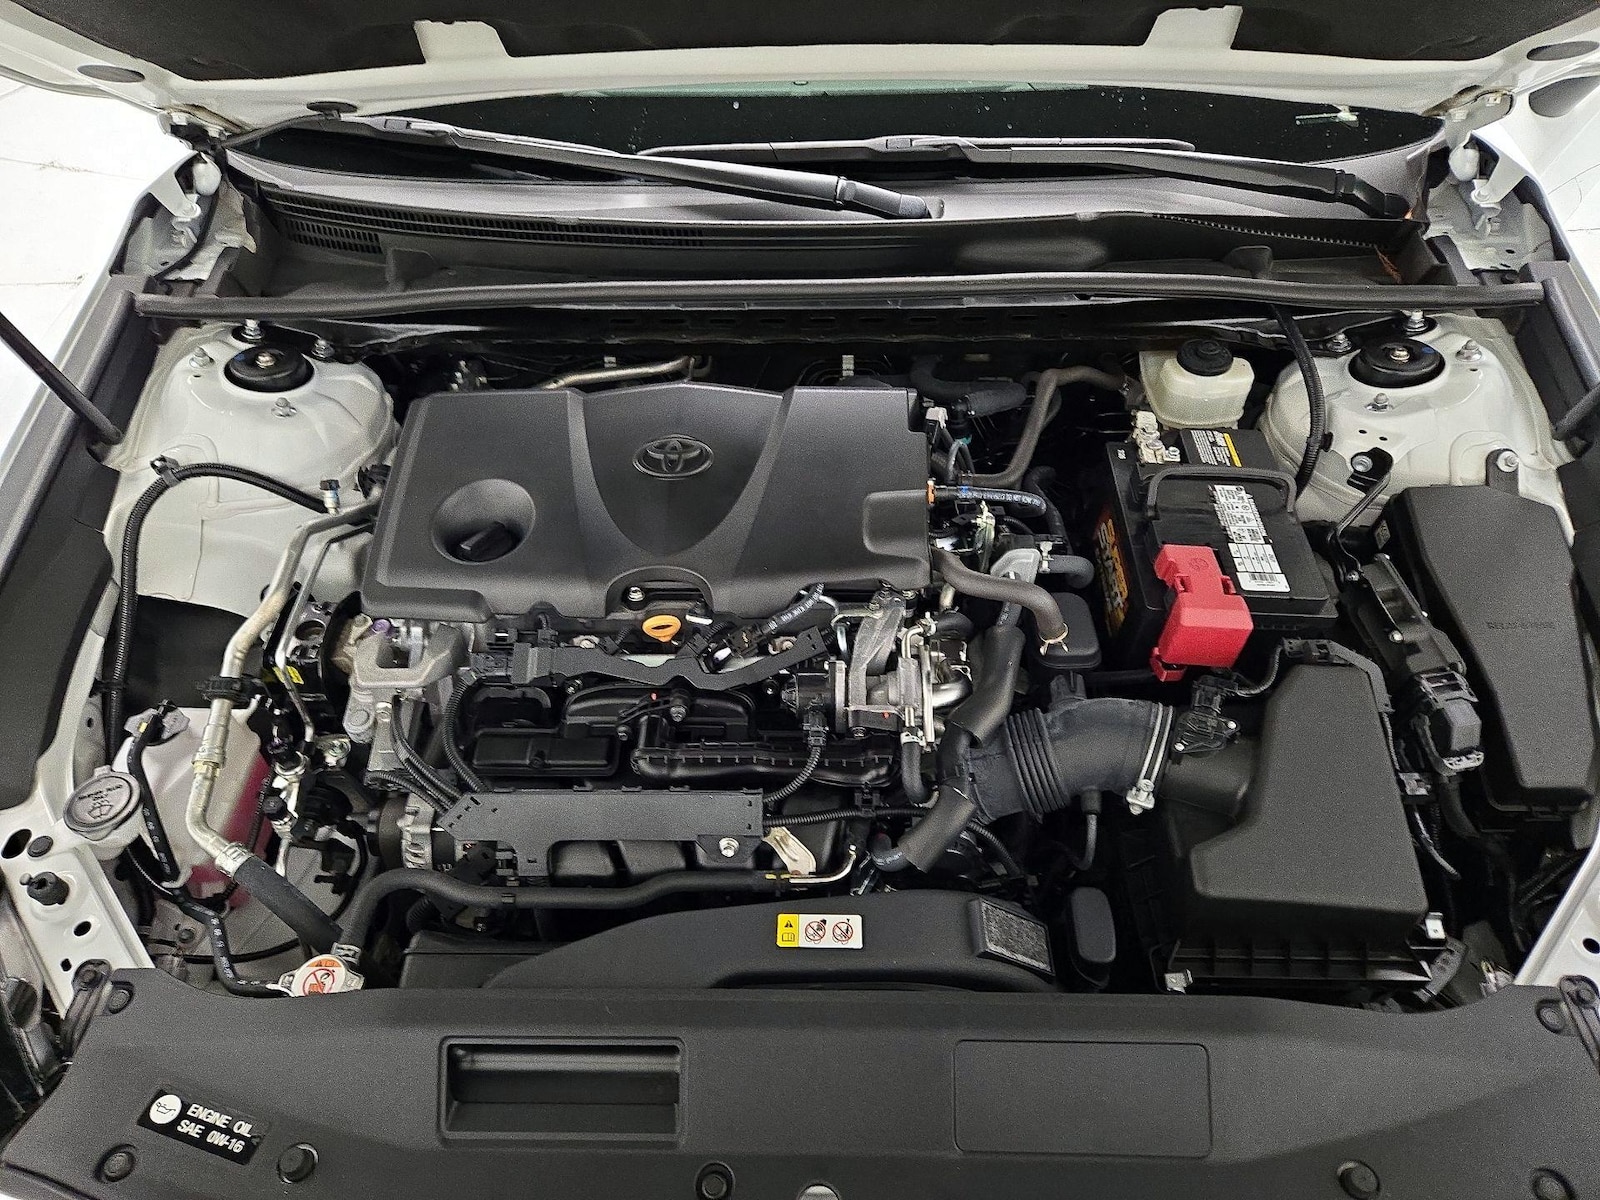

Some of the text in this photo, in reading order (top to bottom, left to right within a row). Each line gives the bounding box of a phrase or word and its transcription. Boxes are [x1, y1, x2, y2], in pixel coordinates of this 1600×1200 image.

[177, 1119, 245, 1153] SAE 0W-16
[187, 1103, 252, 1137] ENGINE OIL
